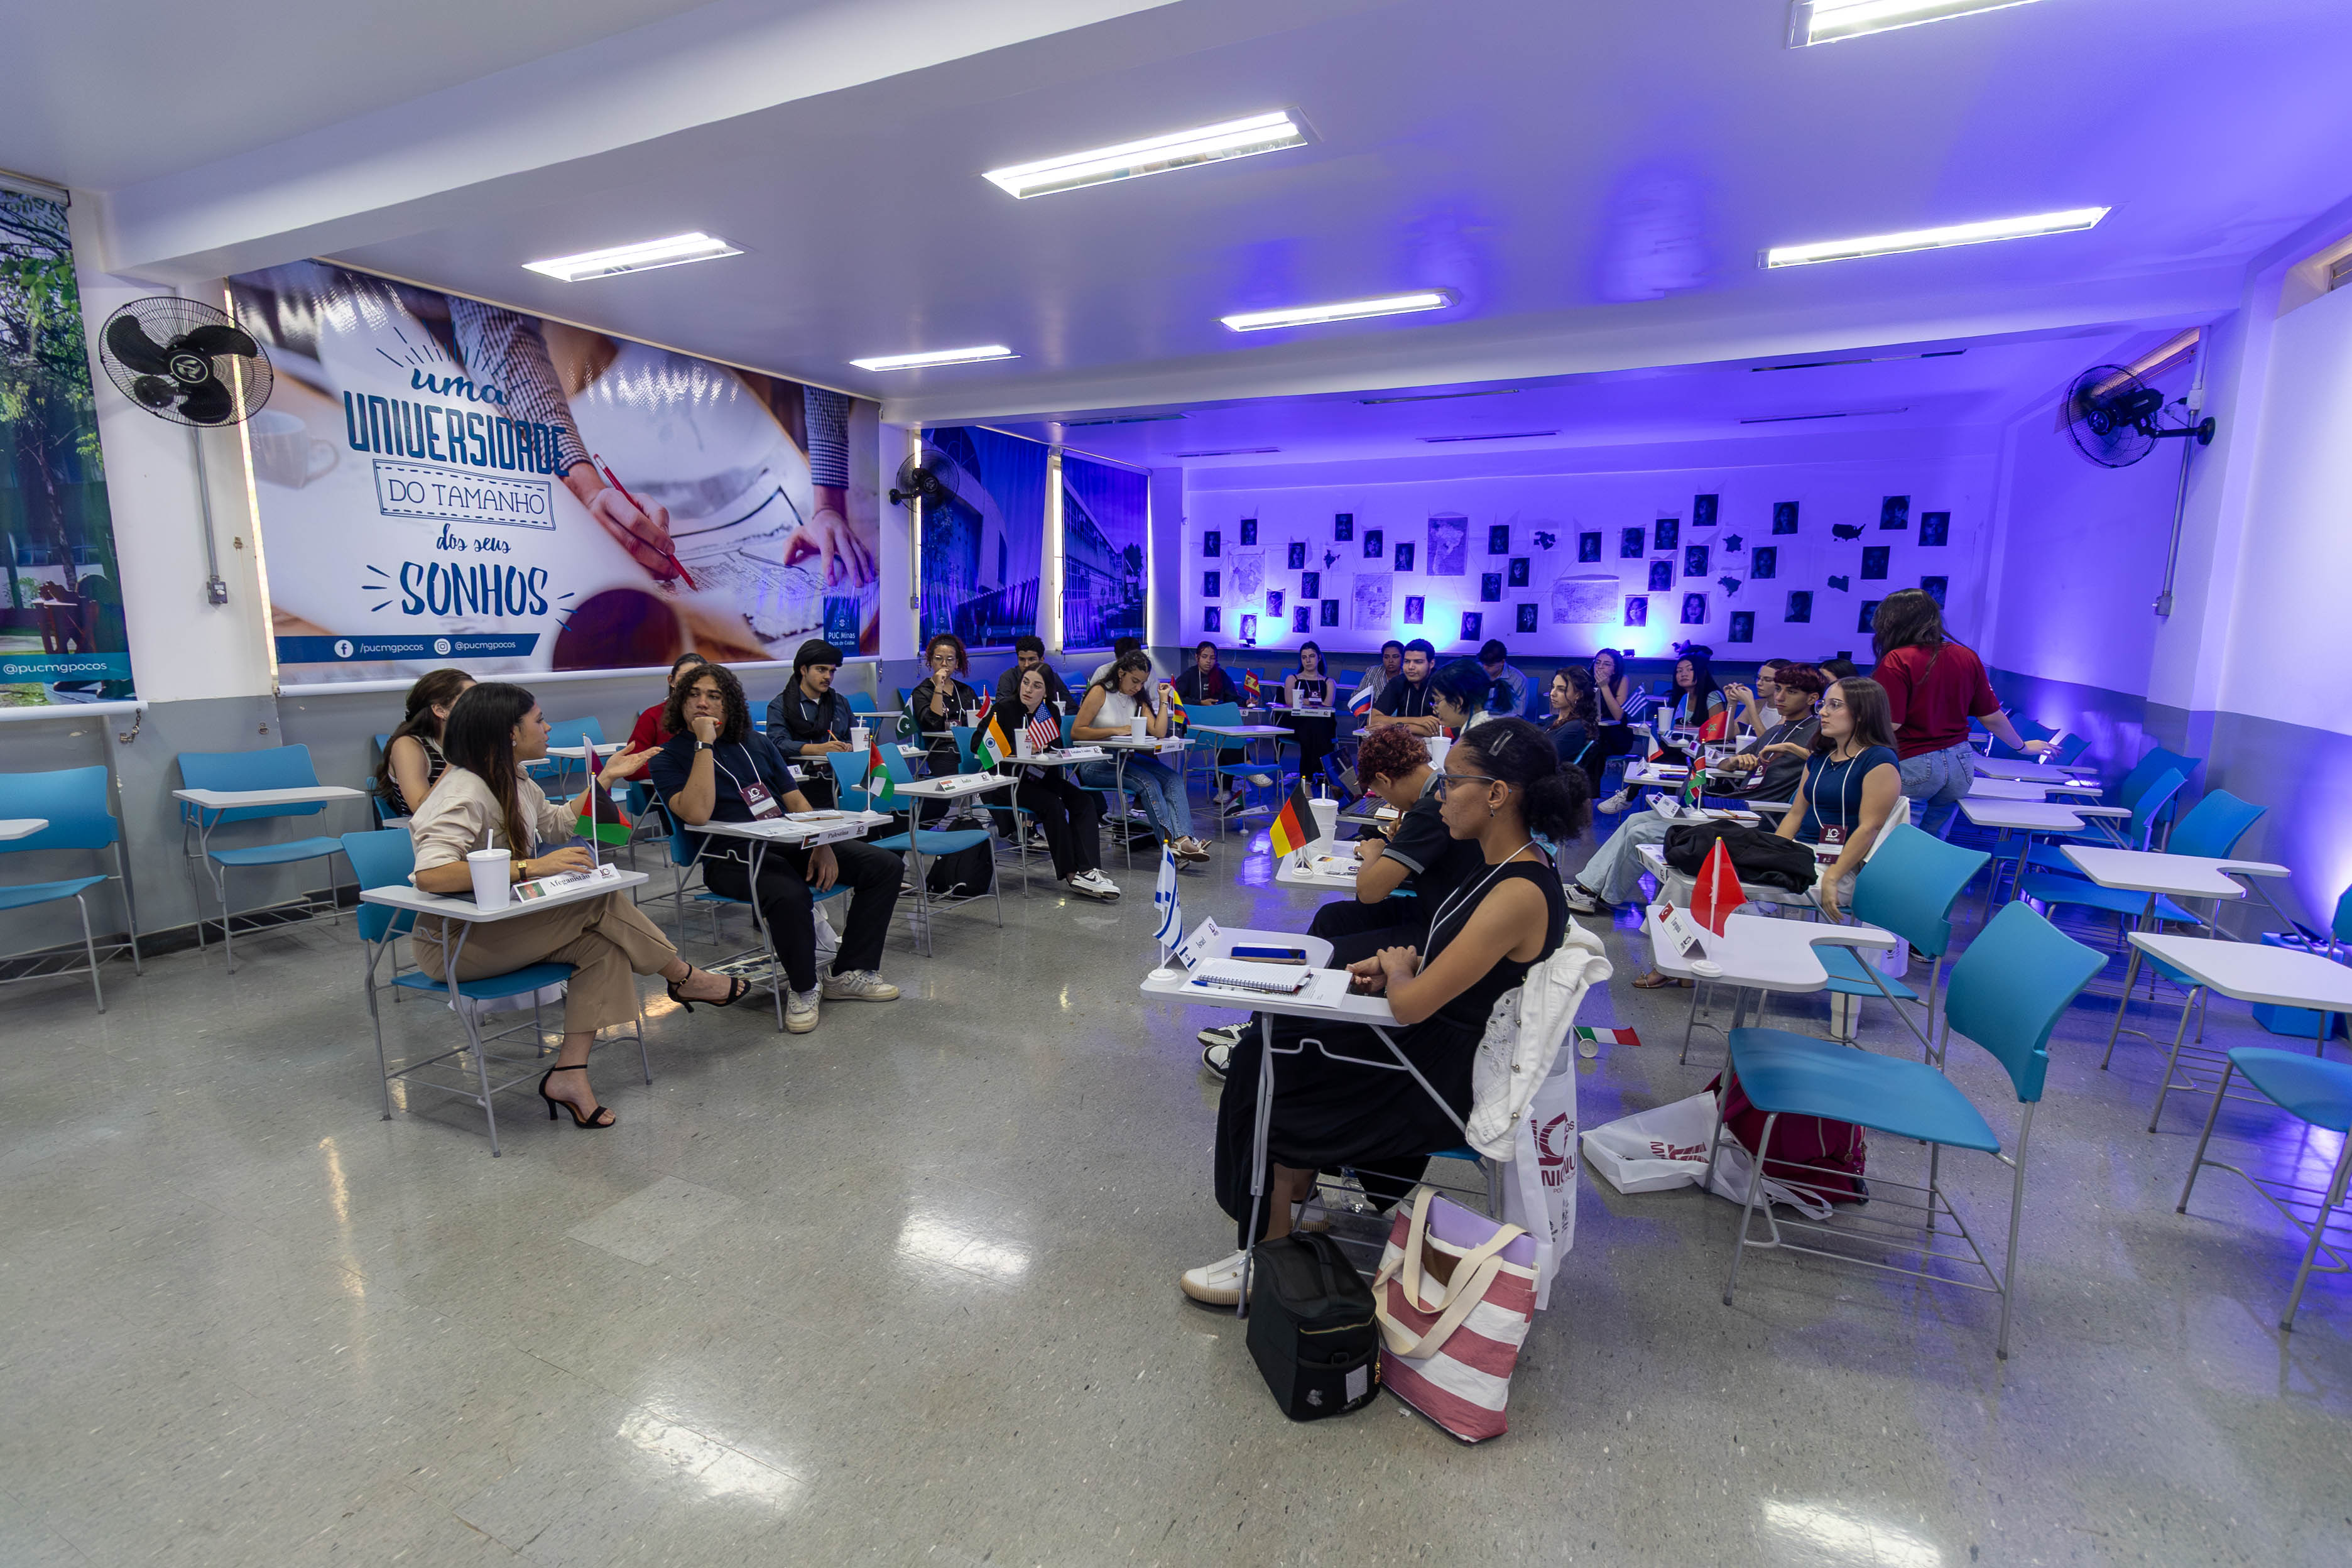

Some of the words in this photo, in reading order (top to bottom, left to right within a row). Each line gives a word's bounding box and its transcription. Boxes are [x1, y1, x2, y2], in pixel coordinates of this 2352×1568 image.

[411, 368, 511, 406] uma
[343, 390, 570, 477] UNIVERSIDADE
[388, 479, 425, 504] DO
[432, 483, 545, 515] TAMANHO
[436, 523, 468, 552] dos
[474, 536, 511, 554] seus
[400, 560, 548, 617] SONHOS
[360, 642, 424, 653] /pucmgpocos
[454, 640, 516, 651] @pucmgpocos
[828, 631, 839, 640] PUC
[841, 630, 856, 639] Minas
[3, 662, 107, 675] @pucmgpocos
[550, 873, 591, 888] Afeganistão
